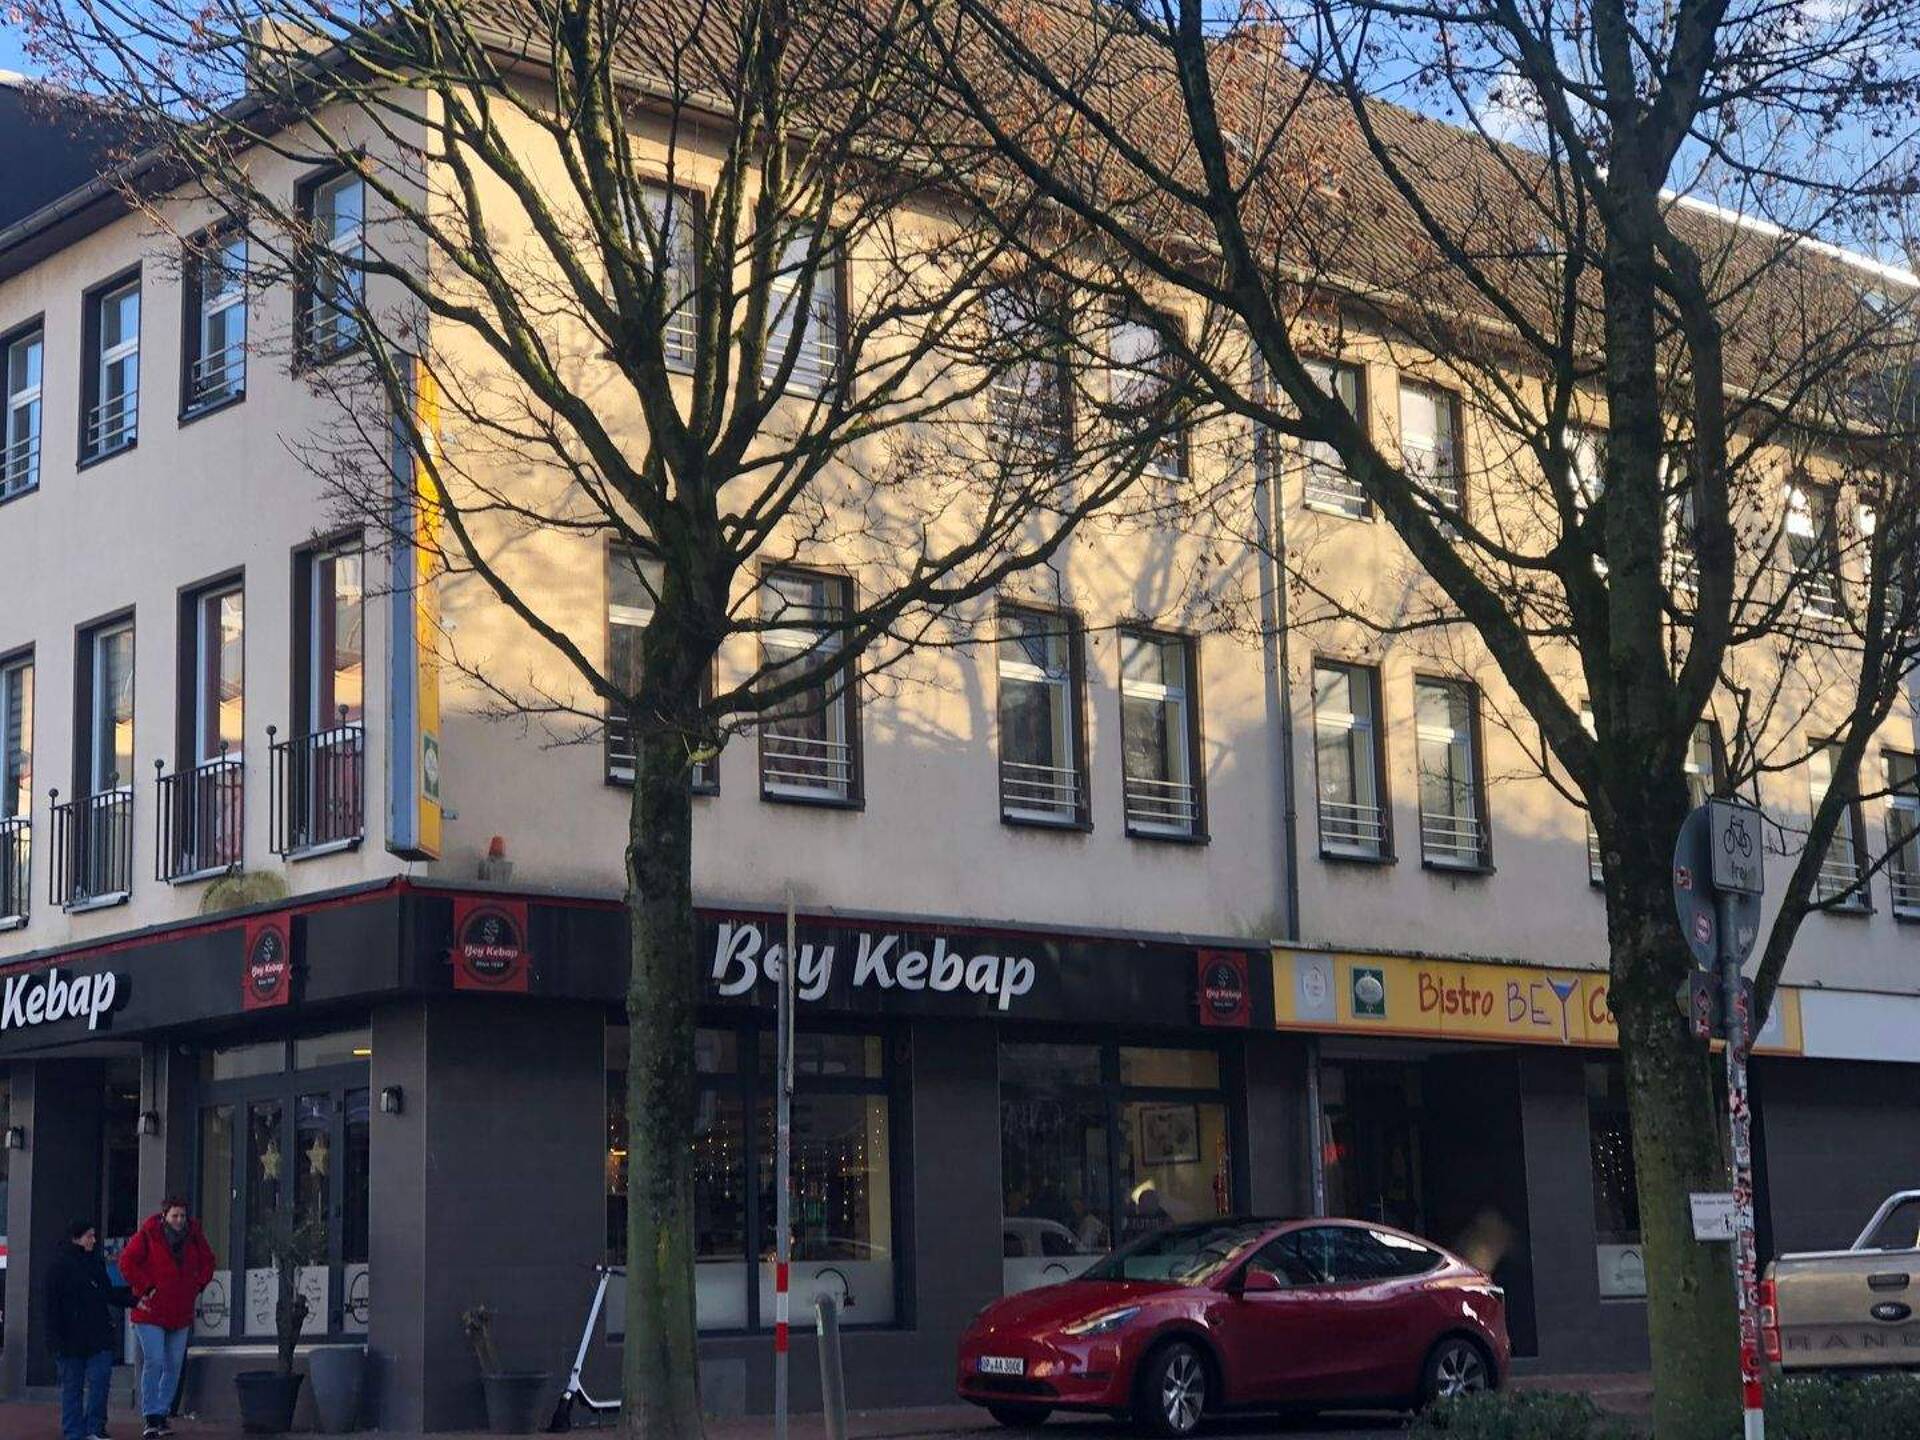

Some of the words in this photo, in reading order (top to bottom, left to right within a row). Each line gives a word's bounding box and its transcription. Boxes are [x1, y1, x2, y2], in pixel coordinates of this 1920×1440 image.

[0, 967, 116, 1030] Kebap
[711, 923, 835, 1001] Bey
[853, 933, 1036, 1011] Kebap
[1418, 972, 1495, 1017] Bistro
[1507, 975, 1579, 1043] BEY
